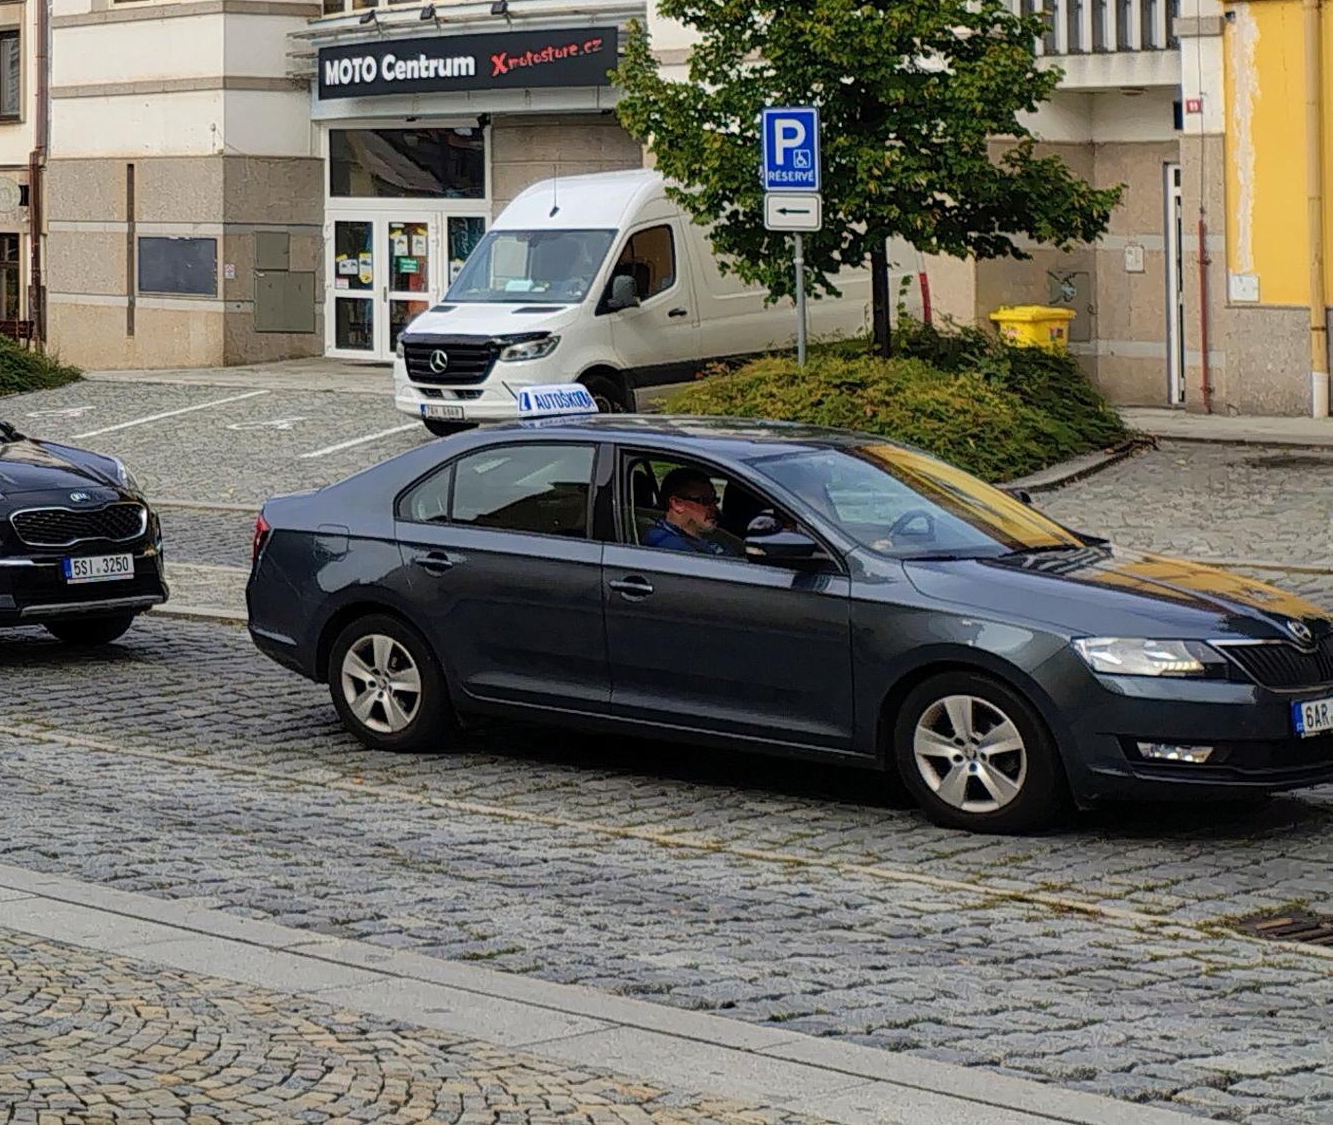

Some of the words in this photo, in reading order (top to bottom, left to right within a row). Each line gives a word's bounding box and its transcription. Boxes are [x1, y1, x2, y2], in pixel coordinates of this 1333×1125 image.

[325, 57, 377, 85] MOTO
[382, 54, 476, 81] Centrum
[774, 118, 806, 166] P
[73, 559, 93, 576] 5SI
[102, 556, 129, 573] 3250
